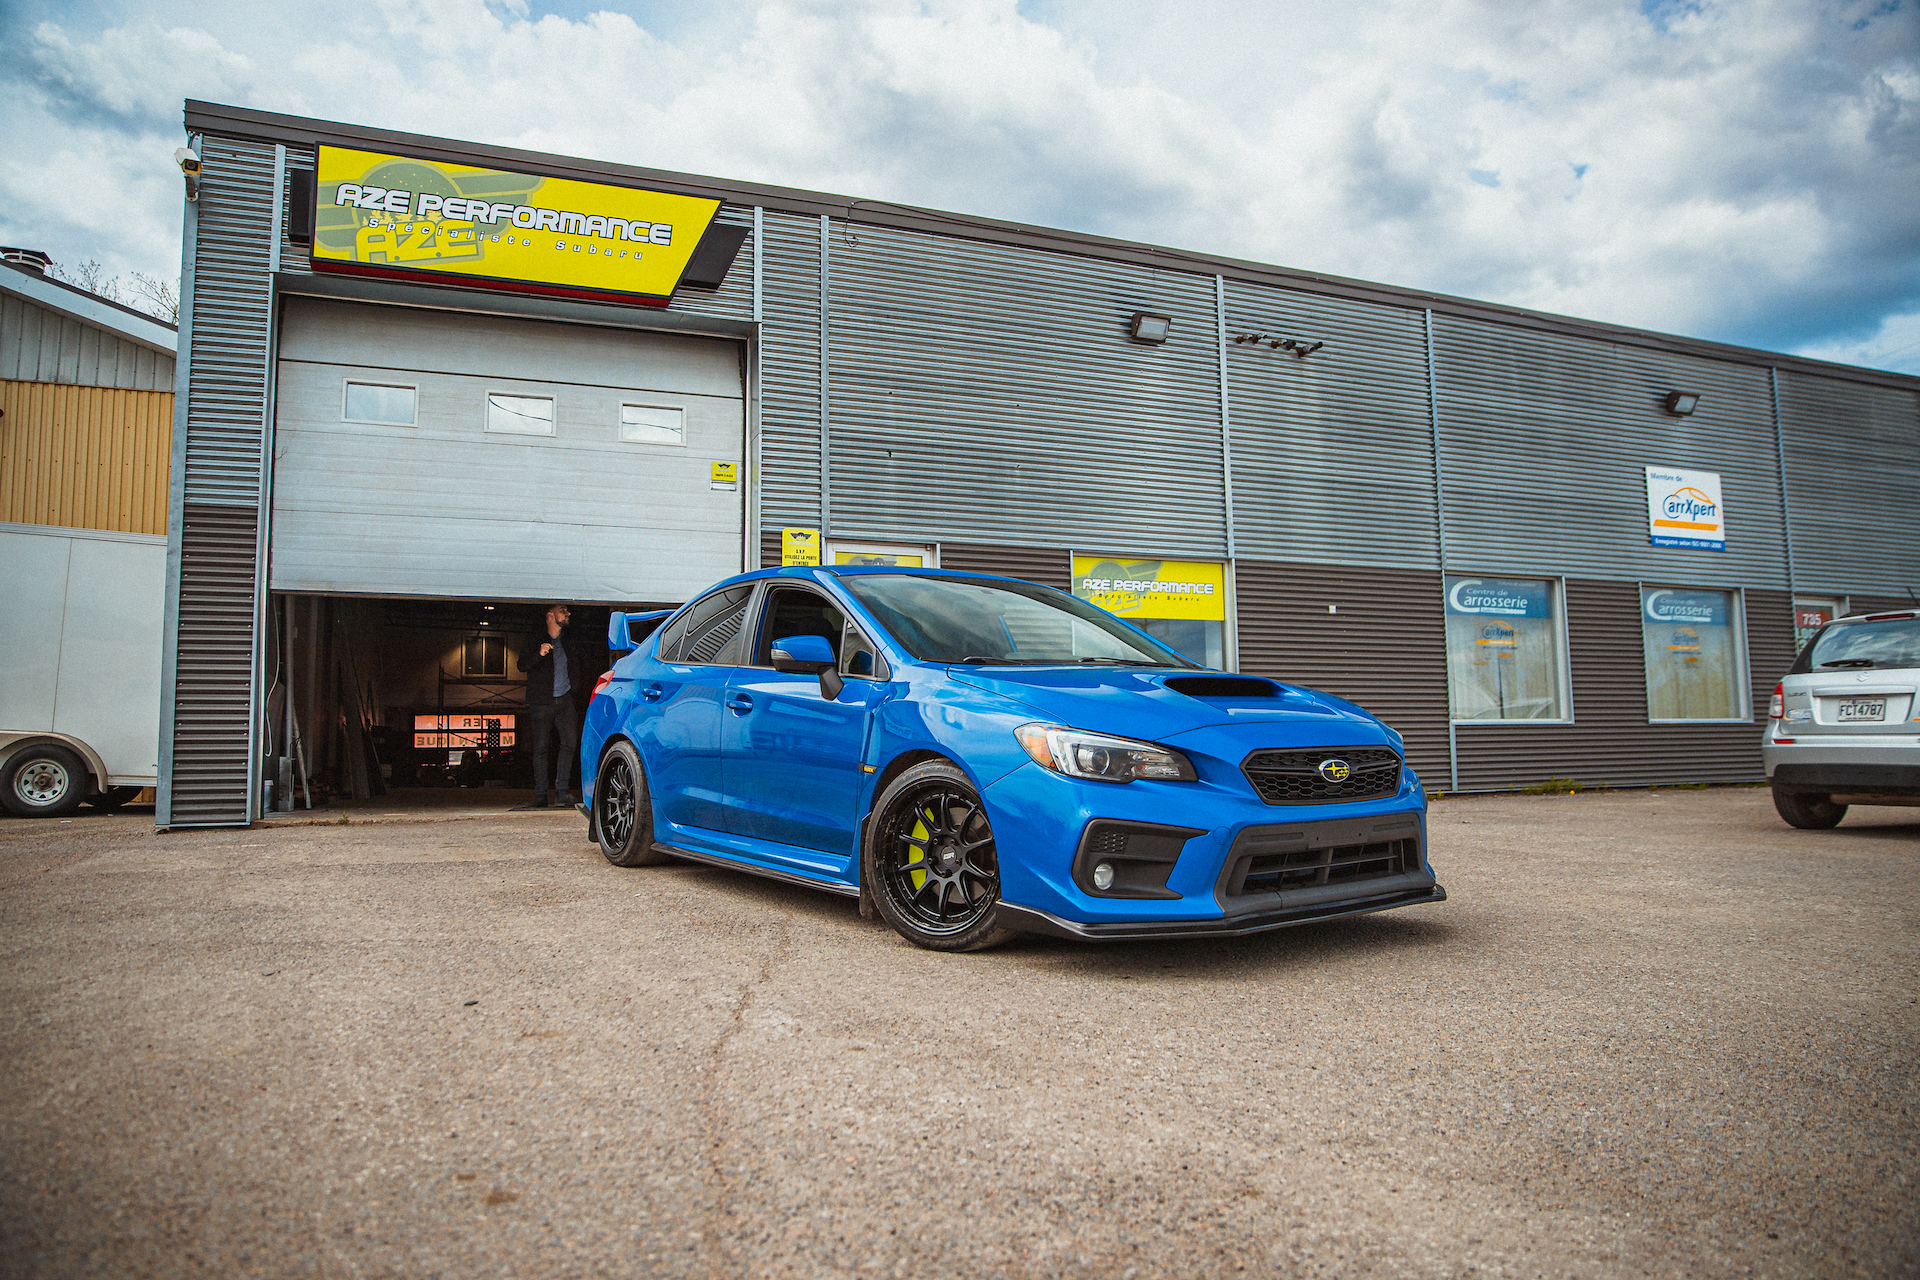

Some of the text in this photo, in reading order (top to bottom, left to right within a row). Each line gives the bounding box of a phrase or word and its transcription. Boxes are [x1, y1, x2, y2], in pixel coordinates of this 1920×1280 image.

[335, 183, 673, 246] AZE PERFORMANCE
[368, 218, 643, 260] Spécialiste Subaru
[1113, 579, 1214, 595] PERFORMANCE
[1450, 580, 1528, 612] Carrosserie
[1466, 587, 1509, 597] Centre de
[1647, 590, 1712, 620] Carrosserie
[1802, 613, 1822, 626] 735
[1839, 704, 1883, 716] FCT4787
